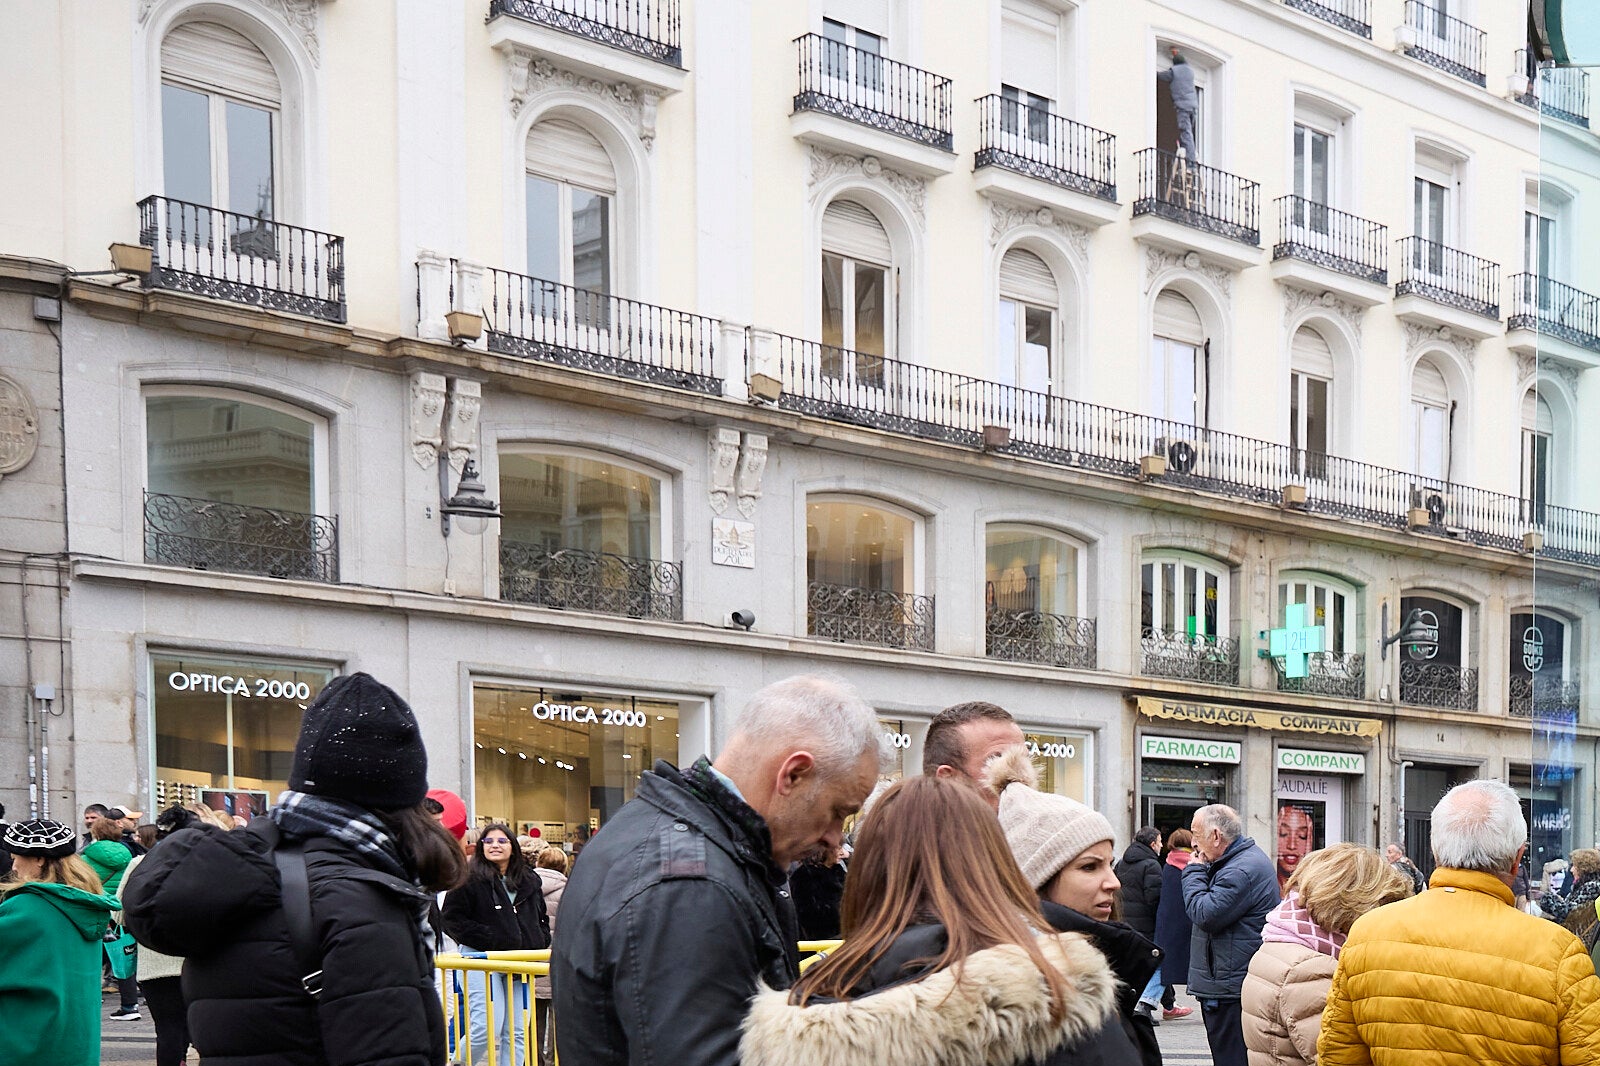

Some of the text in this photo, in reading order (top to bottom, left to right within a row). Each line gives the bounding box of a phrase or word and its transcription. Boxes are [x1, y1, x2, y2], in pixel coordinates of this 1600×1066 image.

[256, 678, 310, 700] 2000
[602, 708, 646, 727] 2000
[1162, 704, 1361, 733] FARMACIA COMPANY
[1437, 733, 1444, 742] 14
[1043, 743, 1075, 759] 2000
[1146, 740, 1236, 759] FARMACIA
[1281, 752, 1360, 769] COMPANY
